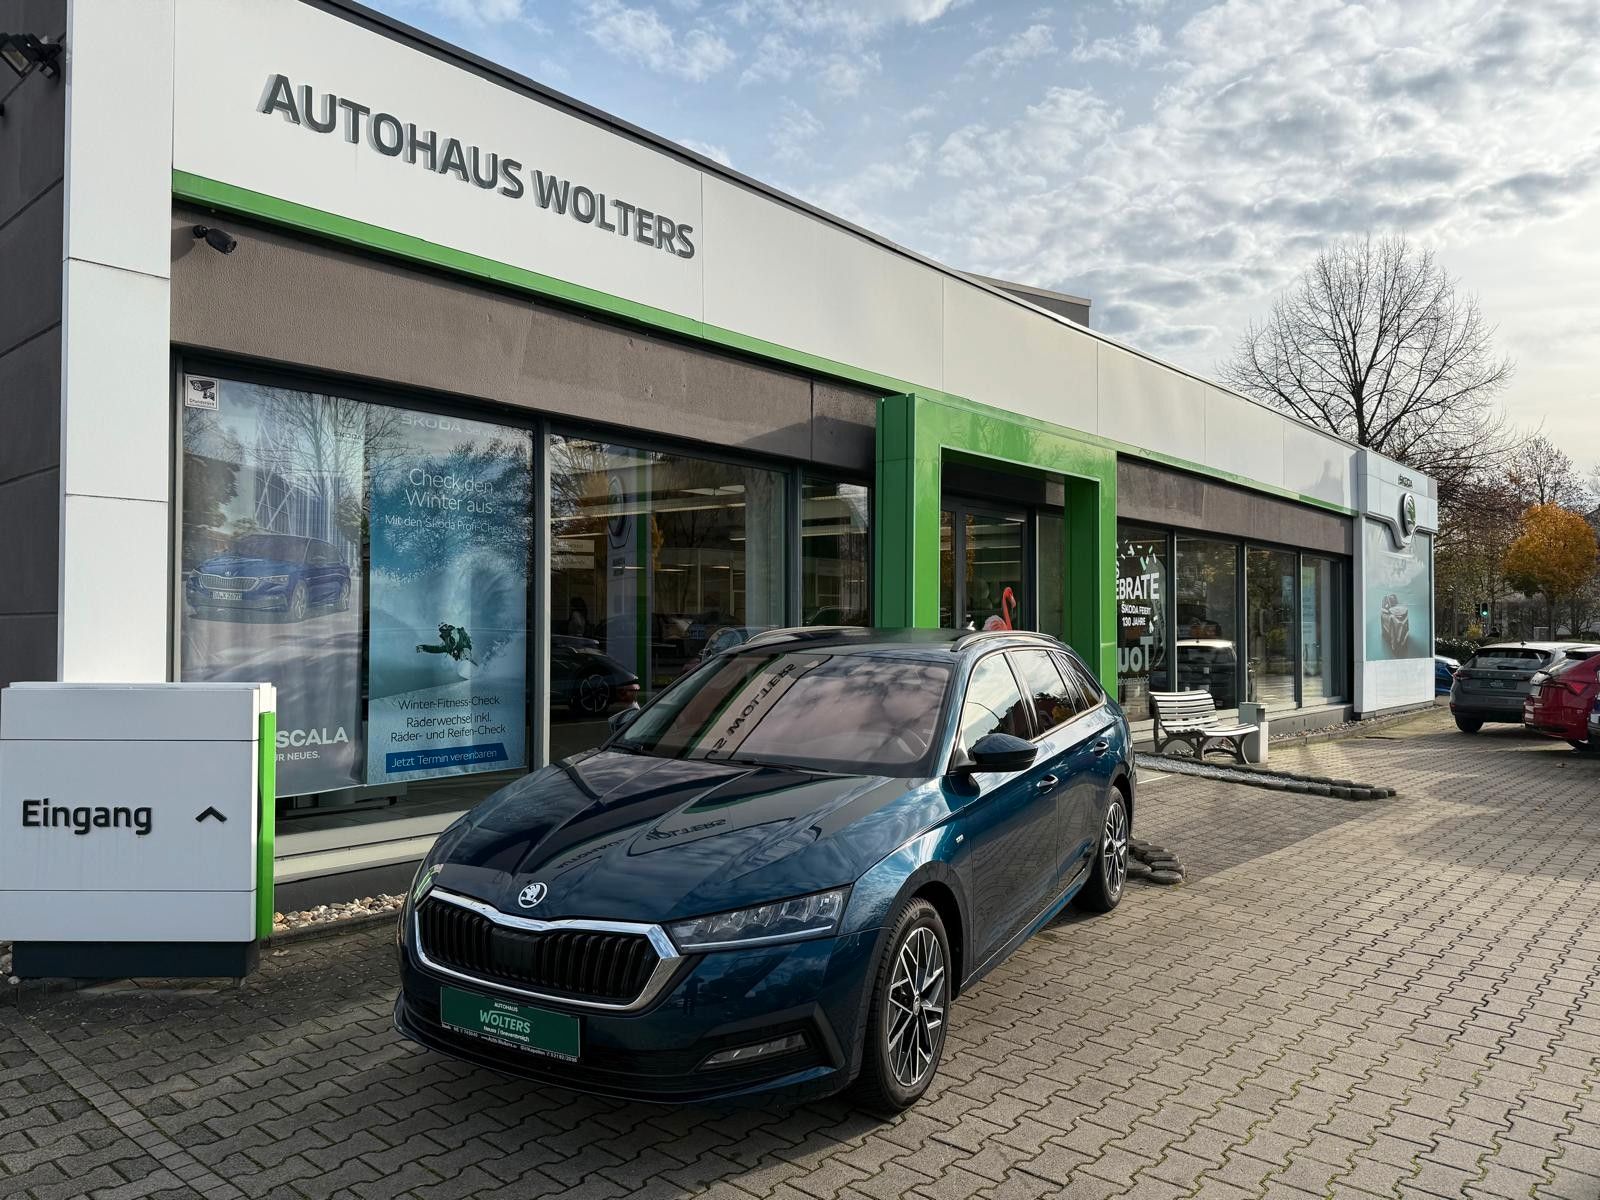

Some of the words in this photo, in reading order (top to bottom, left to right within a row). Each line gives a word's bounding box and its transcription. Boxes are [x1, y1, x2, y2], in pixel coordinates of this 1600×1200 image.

[256, 74, 523, 199] AUTOHAUS
[531, 169, 695, 258] WOLTERS
[409, 468, 461, 490] Check
[464, 476, 493, 494] den
[405, 489, 462, 511] Winter
[467, 499, 497, 514] aus.
[385, 514, 402, 526] Mit
[404, 515, 423, 528] den
[1121, 601, 1138, 615] ŠKODA
[1122, 616, 1132, 627] 130
[1132, 616, 1146, 627] JAHRE
[399, 696, 501, 710] Winter-Fitness-Check
[406, 712, 472, 728] Räderwechsel
[474, 712, 492, 723] inkl.
[276, 726, 349, 748] SCALA
[391, 732, 422, 743] Räder-
[426, 729, 445, 740] und
[447, 724, 506, 738] Reifen-Check
[287, 750, 321, 761] NEUES.
[392, 757, 415, 768] Jetzt
[418, 753, 449, 764] Termin
[450, 749, 497, 761] vereinbaren
[22, 798, 152, 835] Eingang
[494, 1001, 519, 1012] AUTOHAUS
[480, 1009, 532, 1034] WOLTERS
